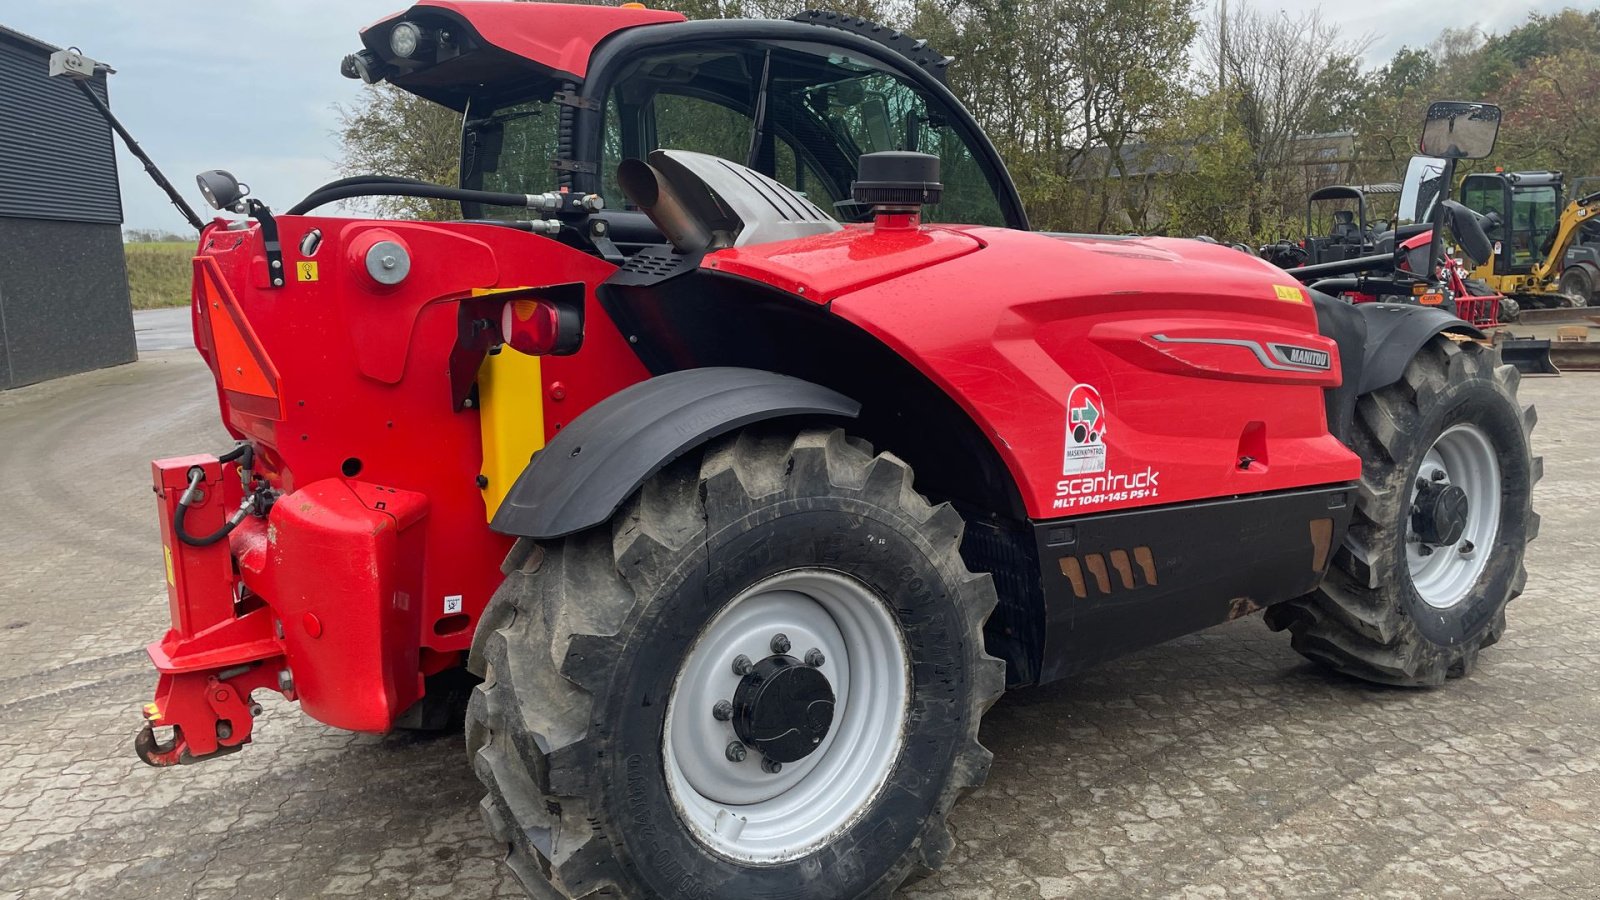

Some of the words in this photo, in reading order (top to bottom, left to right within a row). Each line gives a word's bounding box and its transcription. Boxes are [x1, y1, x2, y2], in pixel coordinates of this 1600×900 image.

[1290, 348, 1327, 366] MANITOU
[1056, 466, 1160, 497] scantruck
[1053, 497, 1077, 509] MLT
[1078, 493, 1128, 506] 1041-145
[1130, 489, 1150, 500] PS+
[1152, 487, 1159, 497] L
